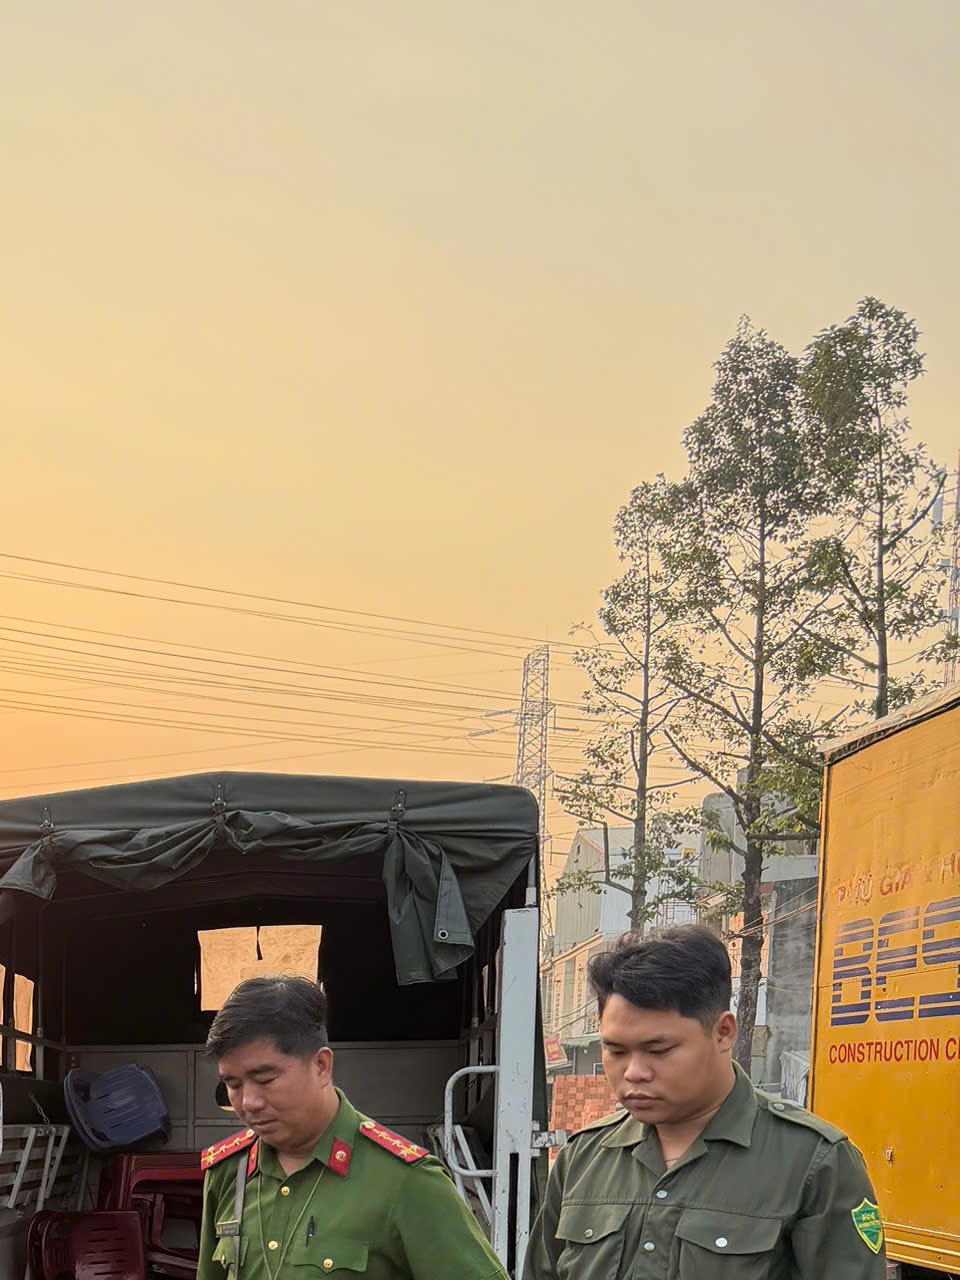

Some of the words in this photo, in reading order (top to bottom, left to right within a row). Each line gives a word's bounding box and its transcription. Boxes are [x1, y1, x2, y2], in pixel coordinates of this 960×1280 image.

[880, 865, 912, 896] GIA
[829, 1038, 940, 1064] CONSTRUCTION
[945, 1036, 960, 1061] C
